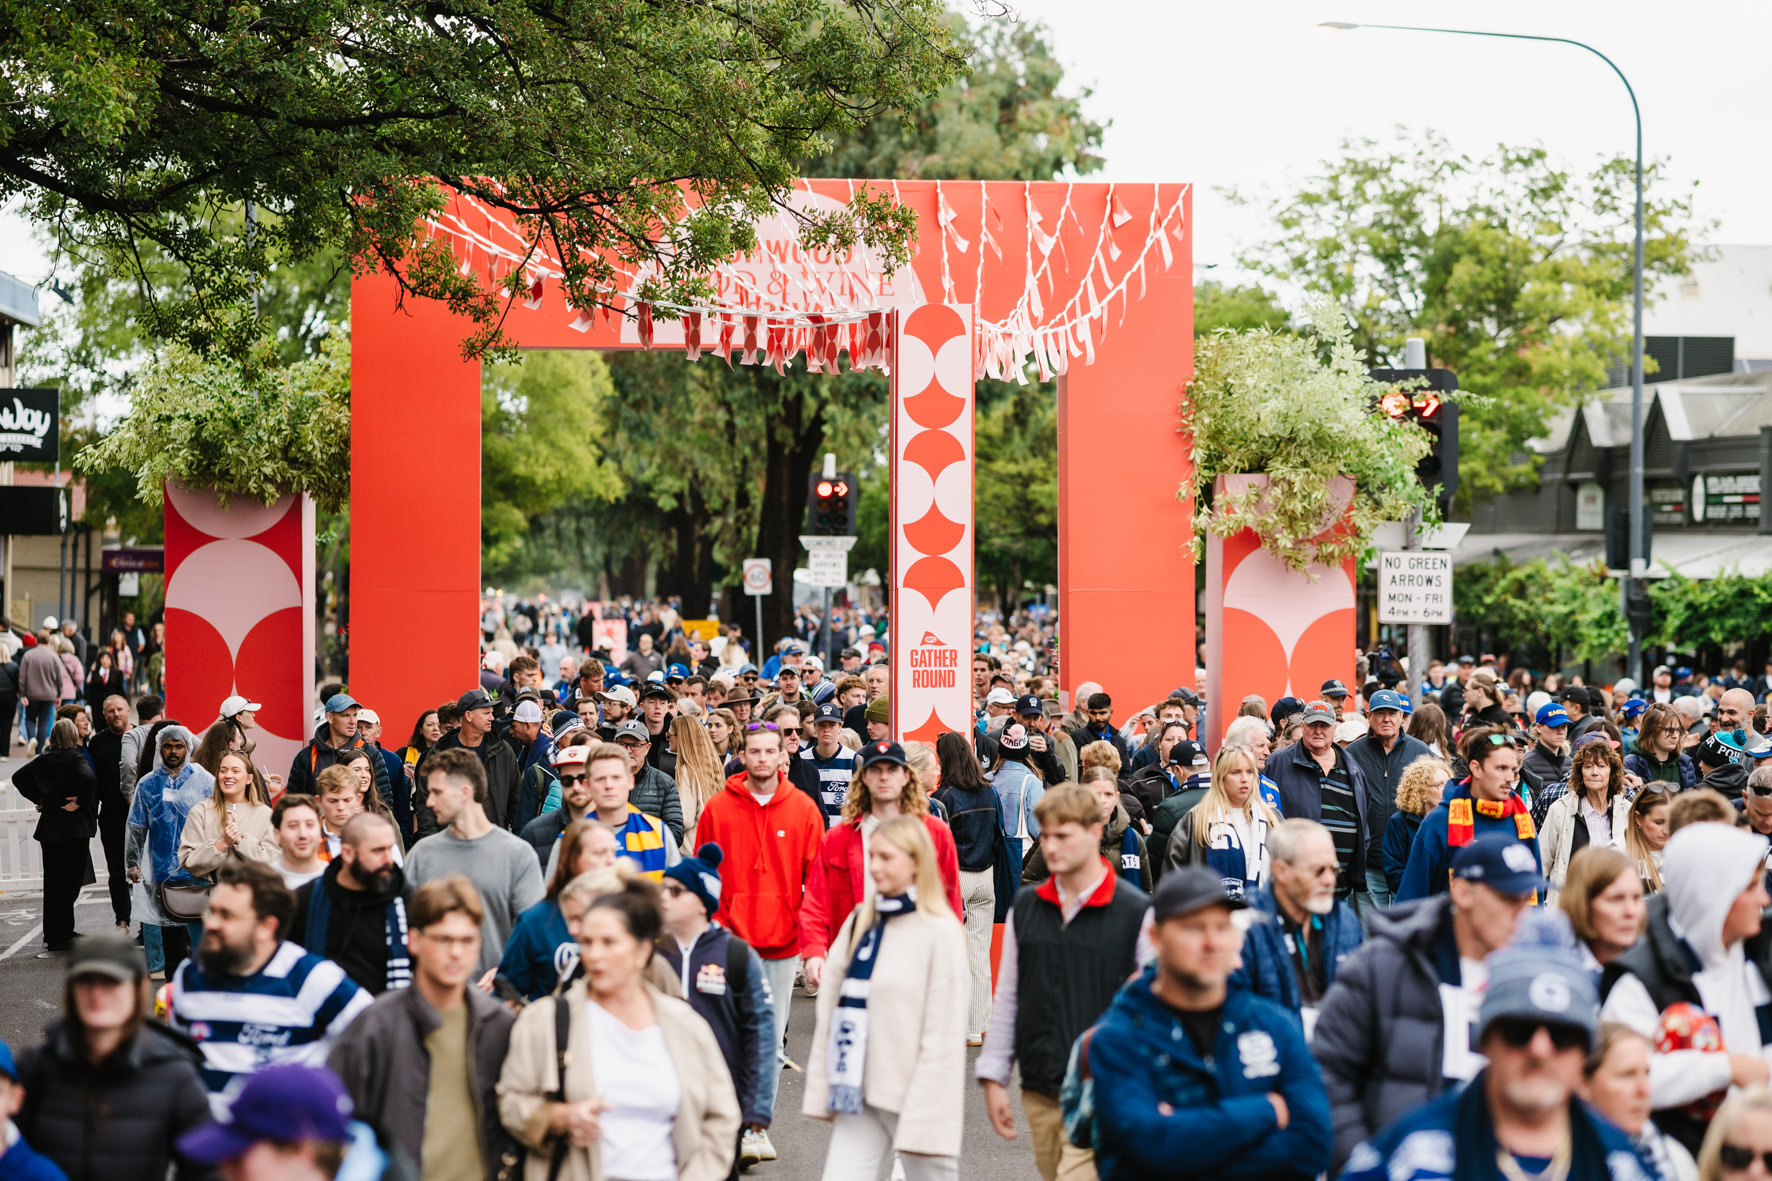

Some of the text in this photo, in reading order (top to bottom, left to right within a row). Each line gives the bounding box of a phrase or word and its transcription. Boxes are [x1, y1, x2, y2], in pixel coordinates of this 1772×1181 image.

[1385, 557, 1448, 570] NO GREEN
[1390, 574, 1442, 587] ARROWS
[1388, 593, 1412, 603] MON
[1425, 593, 1443, 604] FRI
[1388, 606, 1408, 616] 4PM
[1423, 607, 1443, 618] 6PM
[910, 649, 958, 668] GATHER
[912, 669, 956, 689] ROUND
